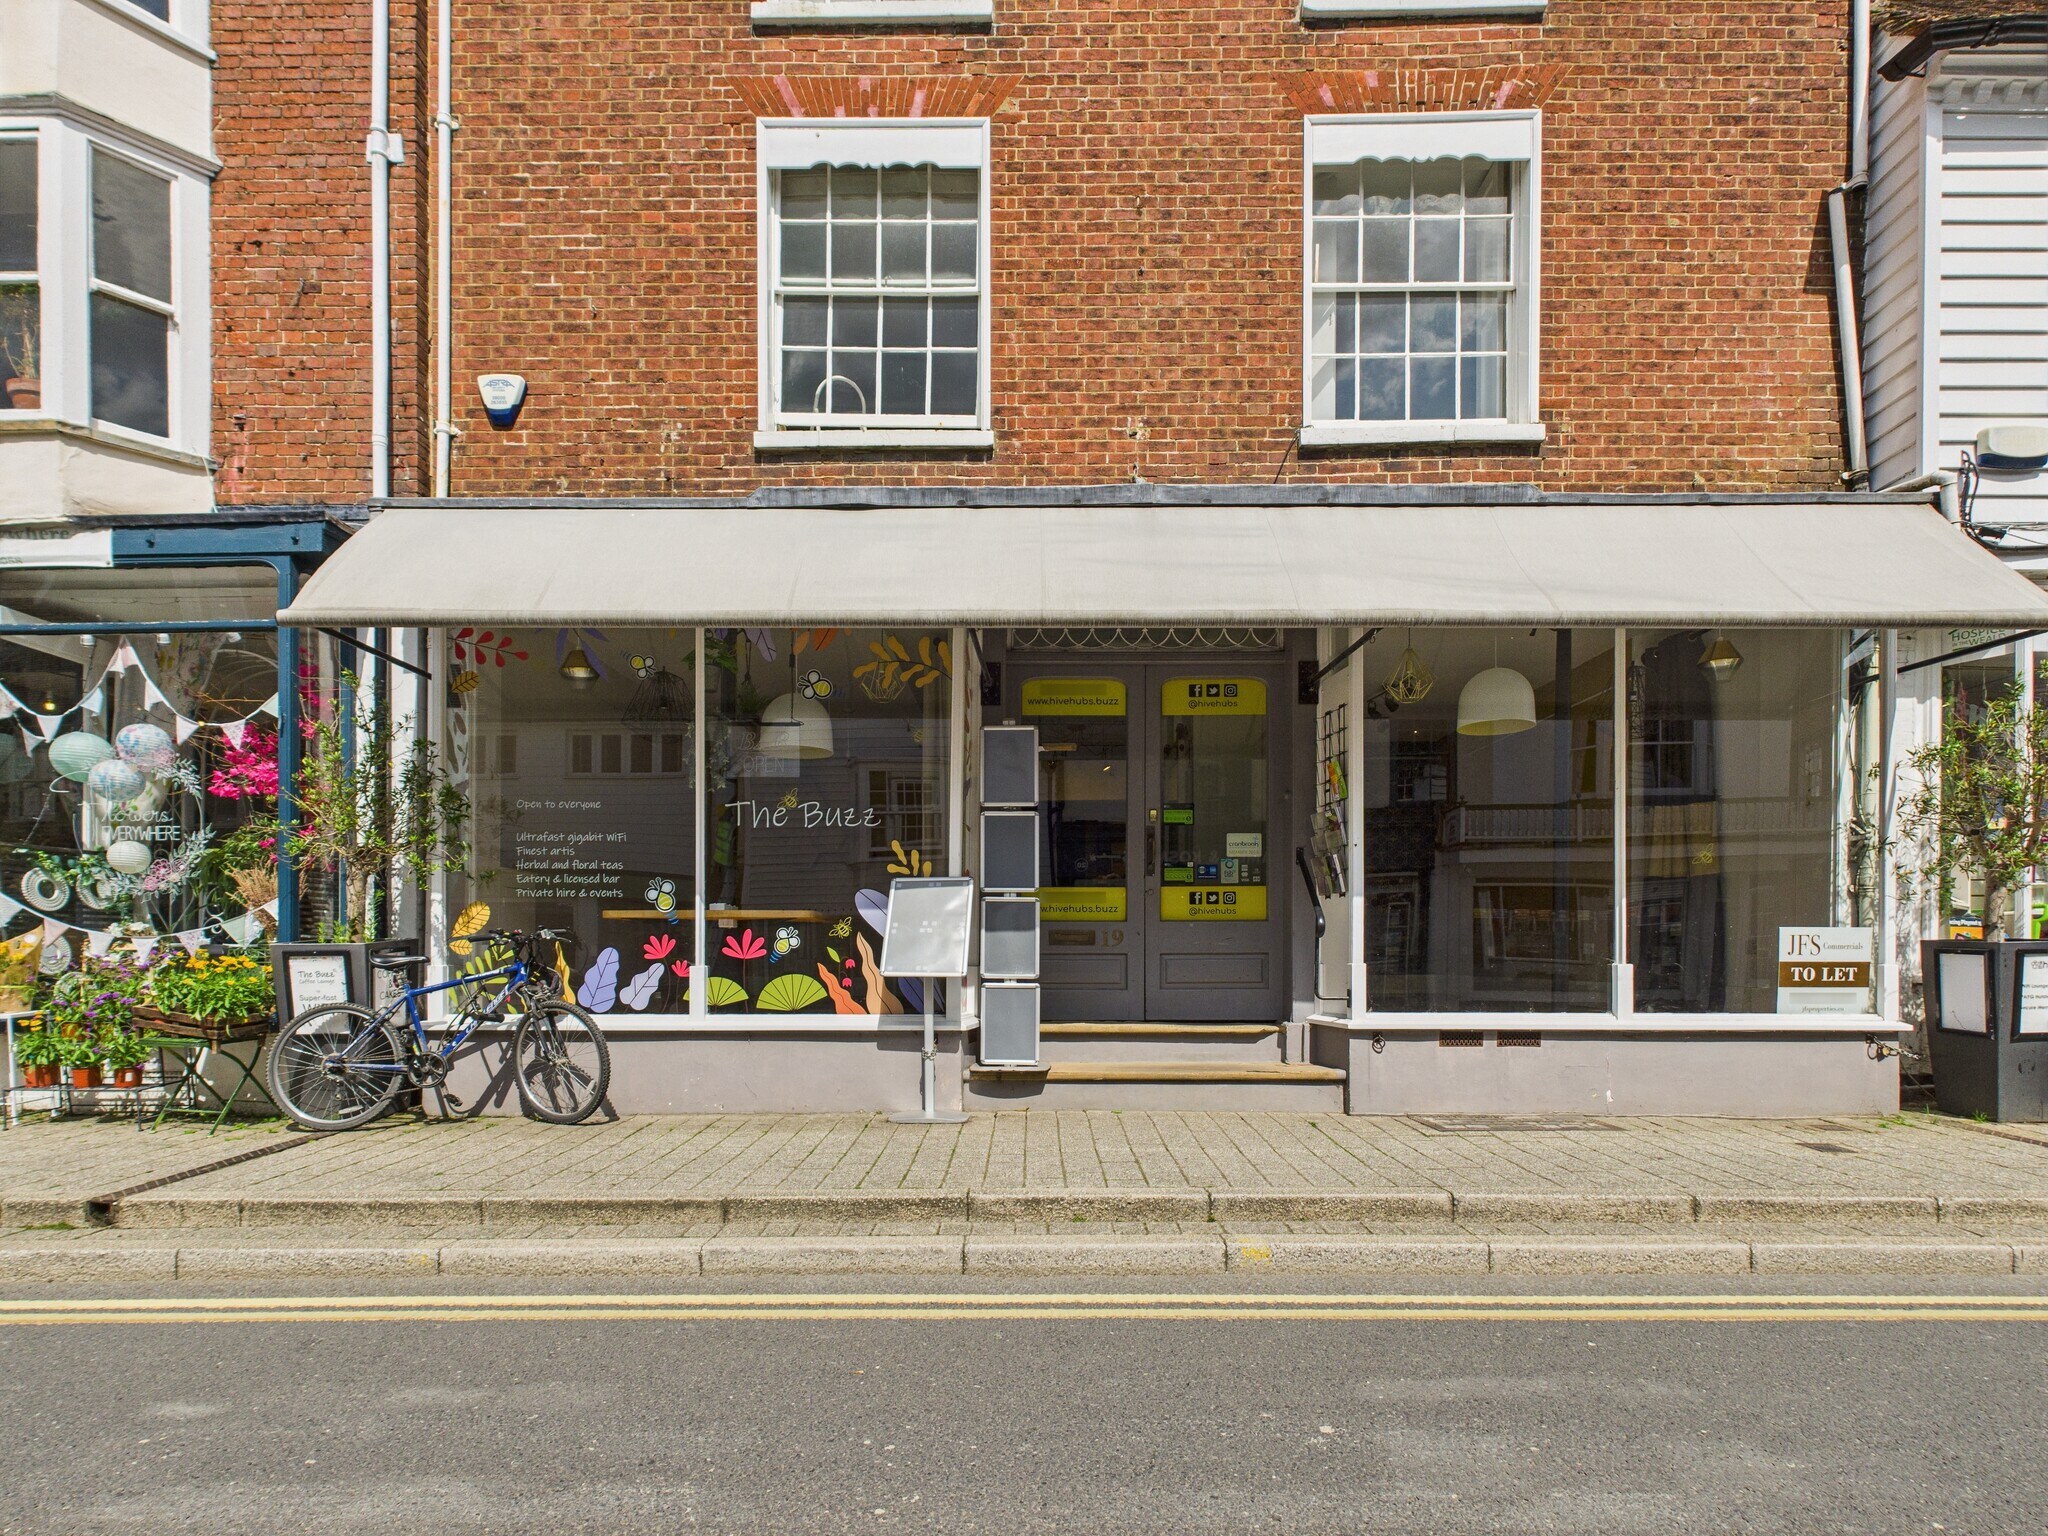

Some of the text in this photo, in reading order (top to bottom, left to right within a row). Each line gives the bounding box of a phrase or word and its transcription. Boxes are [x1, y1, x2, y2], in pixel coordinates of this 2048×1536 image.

[1027, 696, 1120, 706] www.hivehubs.buzz
[1188, 699, 1238, 709] @hivehubs
[743, 755, 785, 773] OPEN
[516, 799, 601, 811] Open to everyone
[725, 800, 882, 829] The Buzz
[516, 831, 627, 845] Ultrafast gigabit WiFi
[516, 845, 576, 856] Finest artis
[516, 859, 624, 871] Herbal and floral teas
[516, 873, 621, 886] Eatery & licensed bar
[516, 887, 624, 898] Private hire & events
[1040, 903, 1119, 914] w.hivehubs.buzz
[1187, 906, 1238, 915] @hivehubs
[1102, 929, 1125, 947] 19
[1787, 934, 1864, 956] JFS Commercials
[297, 970, 313, 978] The
[1790, 966, 1858, 982] TO LET
[299, 994, 338, 1002] Super-fast
